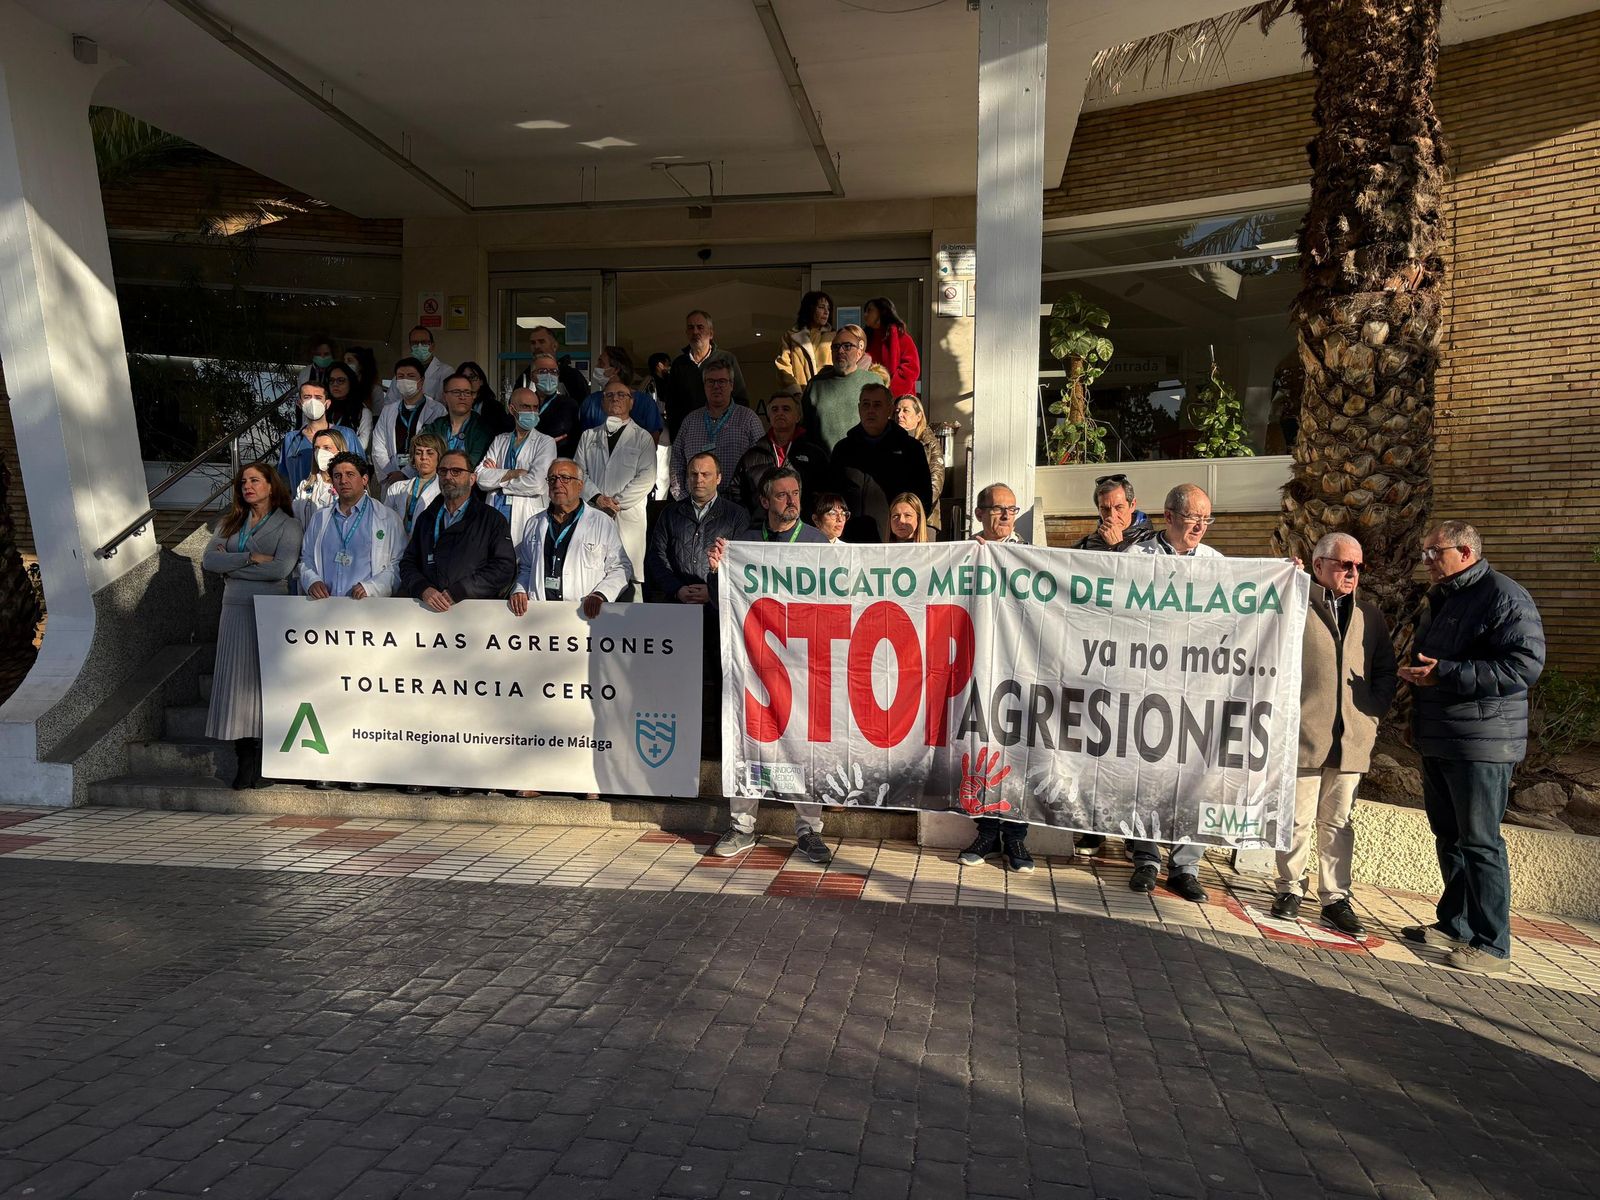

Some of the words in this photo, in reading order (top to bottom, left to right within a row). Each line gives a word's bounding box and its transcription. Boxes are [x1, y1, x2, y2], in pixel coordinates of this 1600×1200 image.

[743, 563, 917, 598] SINDICATO
[927, 554, 1058, 602] MÉDICO
[1070, 575, 1115, 608] DE
[1125, 571, 1284, 615] MÁLAGA
[284, 628, 397, 648] CONTRA
[416, 632, 468, 649] LAS
[486, 633, 675, 655] AGRESIONES
[1081, 638, 1116, 676] ya
[1130, 642, 1168, 671] no
[1181, 634, 1277, 678] más...
[340, 675, 524, 698] TOLERANCIA
[542, 682, 617, 701] CERO
[743, 596, 976, 749] STOP
[352, 727, 403, 745] Hospital
[405, 730, 460, 747] Regional
[462, 731, 546, 748] Universitario
[548, 733, 565, 748] de
[567, 733, 613, 752] Málaga
[956, 677, 1273, 772] AGRESIONES
[772, 766, 802, 775] SINDICATO
